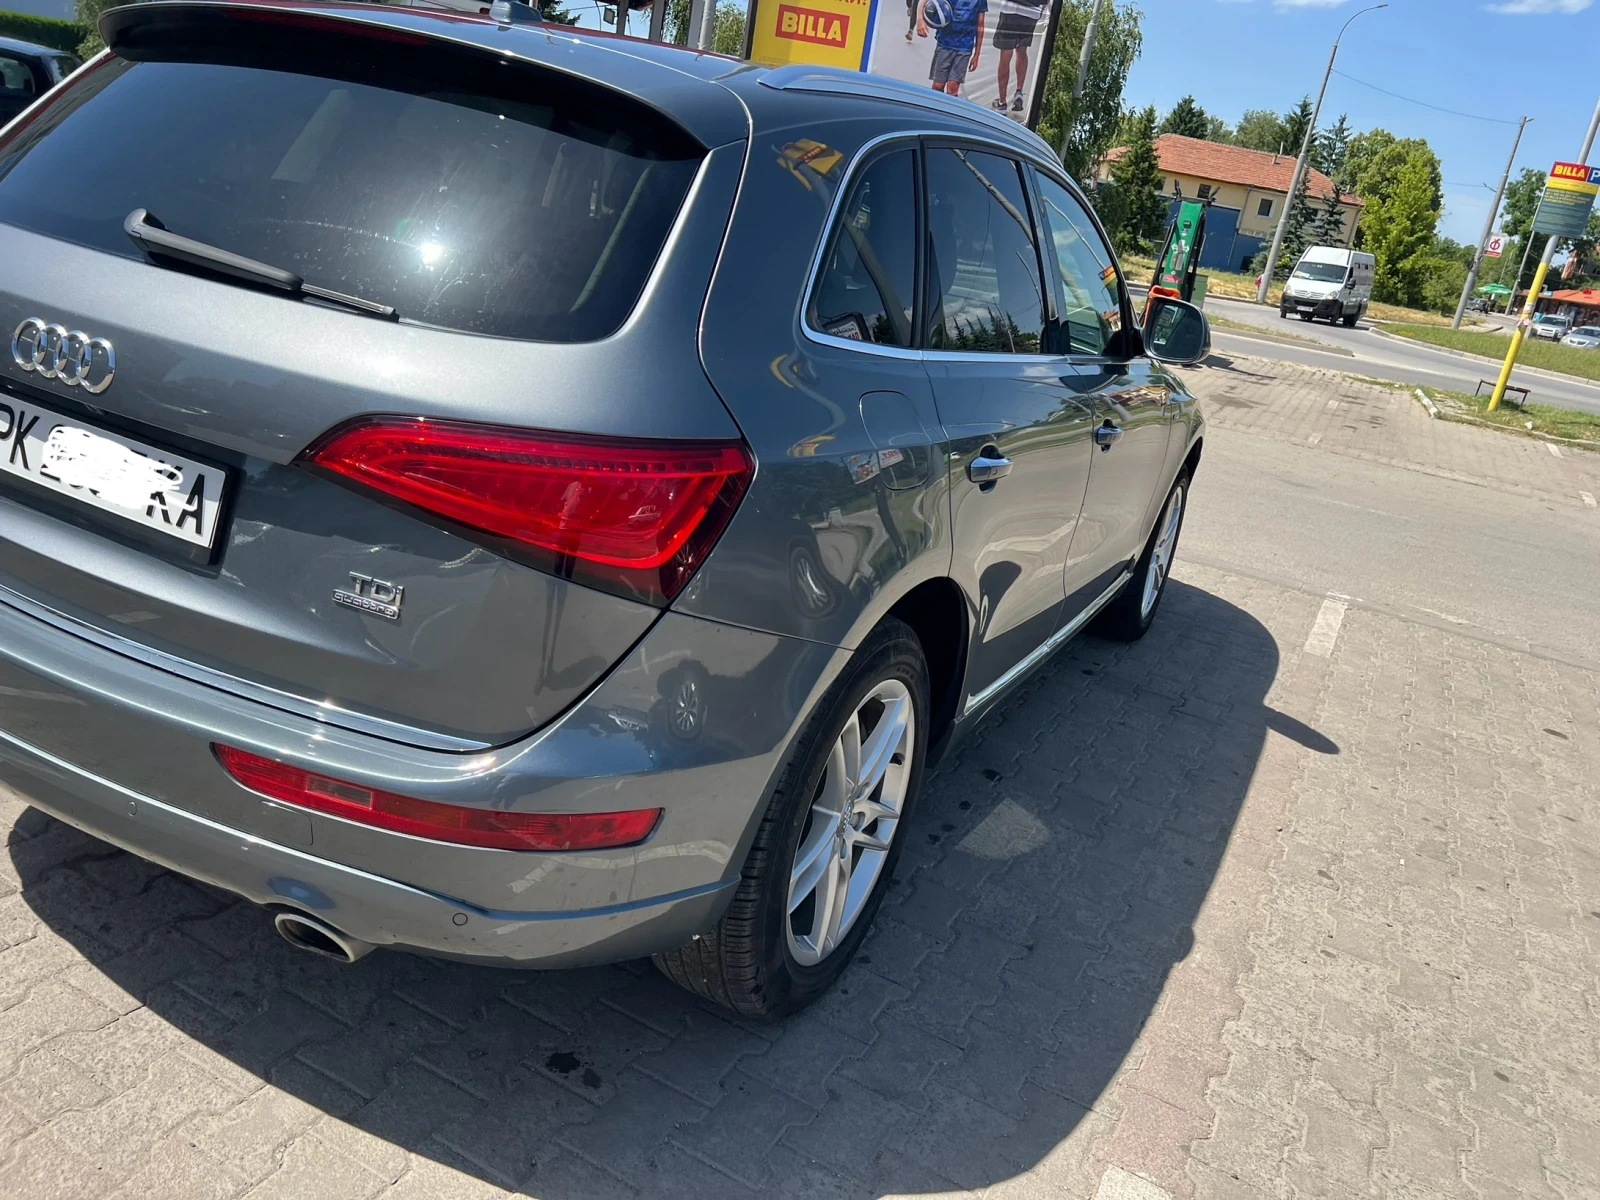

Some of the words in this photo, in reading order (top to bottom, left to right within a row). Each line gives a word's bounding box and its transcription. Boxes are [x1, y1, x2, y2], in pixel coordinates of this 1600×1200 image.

[781, 11, 842, 42] BILLA
[1554, 165, 1585, 178] BILLA
[349, 571, 403, 607] TDI
